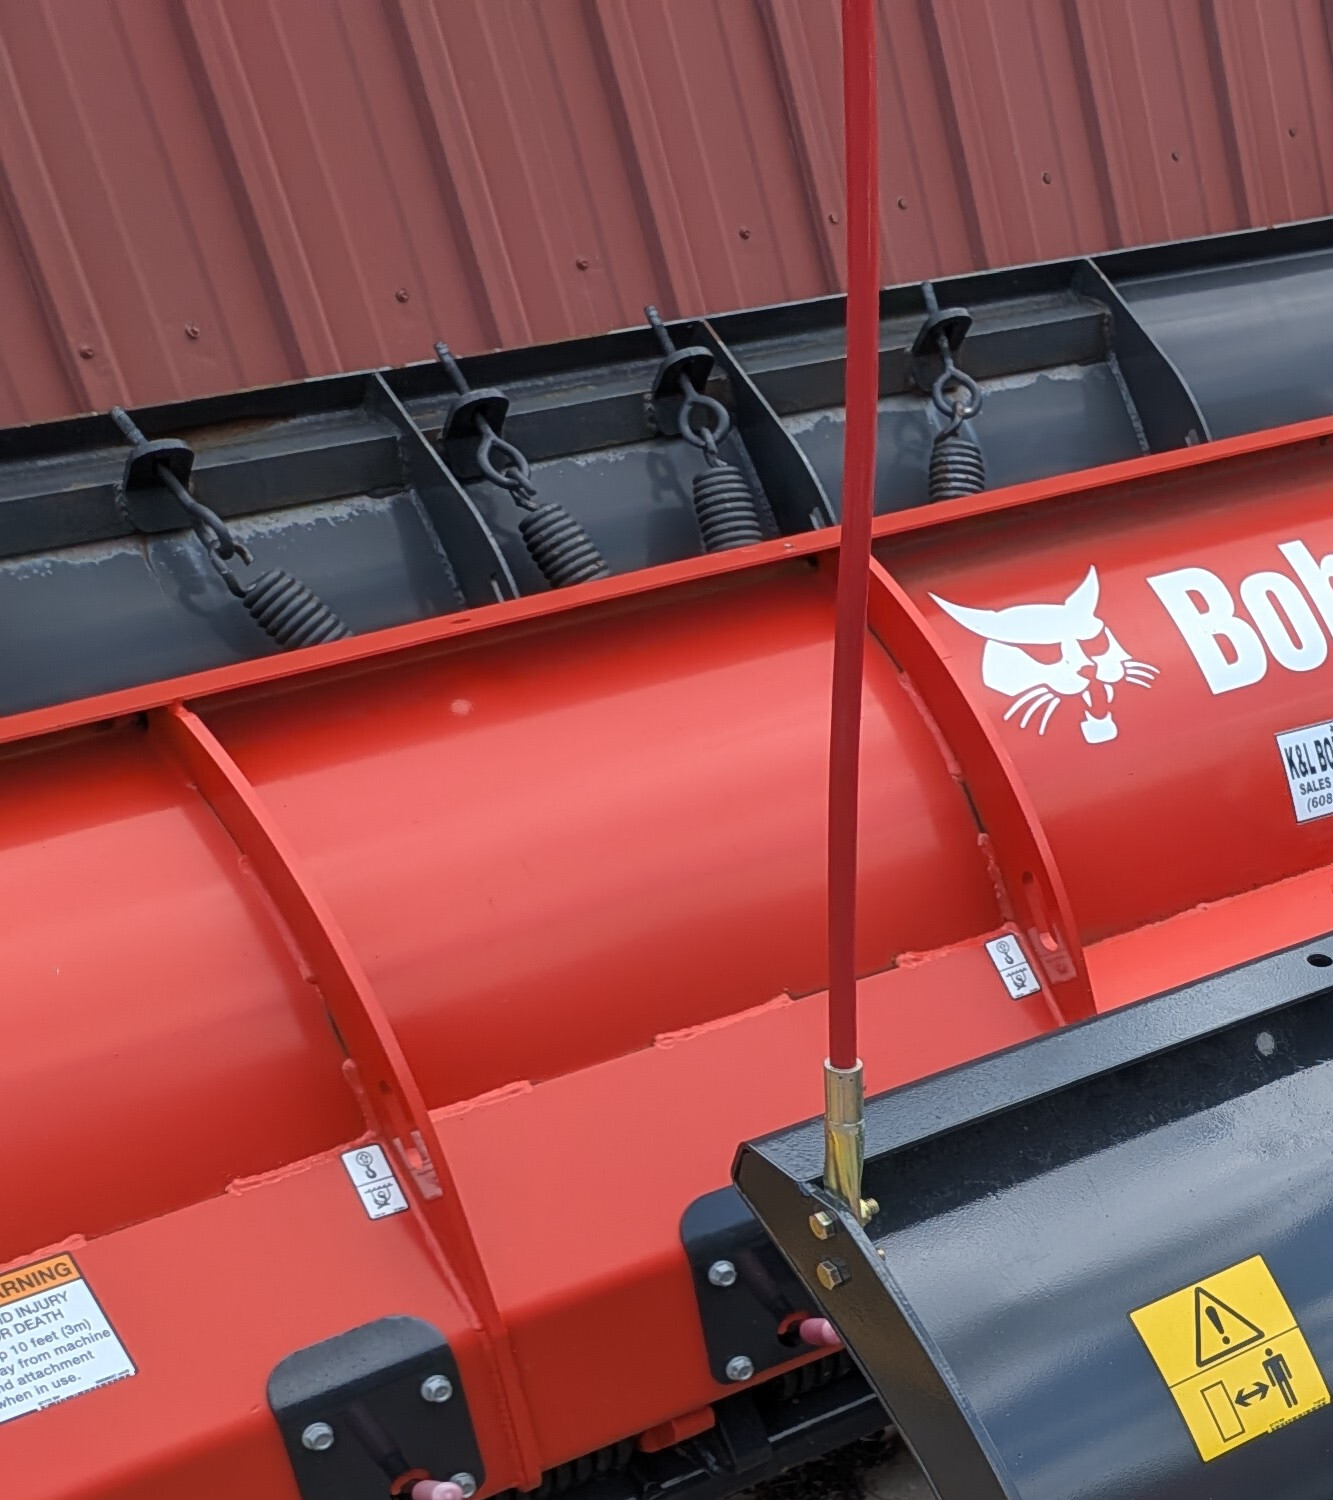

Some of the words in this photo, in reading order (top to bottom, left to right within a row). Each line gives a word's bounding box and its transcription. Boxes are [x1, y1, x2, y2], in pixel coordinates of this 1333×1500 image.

[1284, 742, 1317, 780] K&L
[1299, 776, 1332, 796] SALES
[0, 1262, 73, 1299] RNING
[13, 1308, 65, 1336] DEATH
[16, 1290, 69, 1319] INJURY
[11, 1342, 29, 1356] 10
[30, 1330, 60, 1347] feet
[60, 1318, 92, 1339] (3m)
[17, 1351, 51, 1369] from
[53, 1328, 111, 1356] machine
[18, 1349, 96, 1387] attachment
[35, 1383, 50, 1396] in
[51, 1375, 82, 1389] use.
